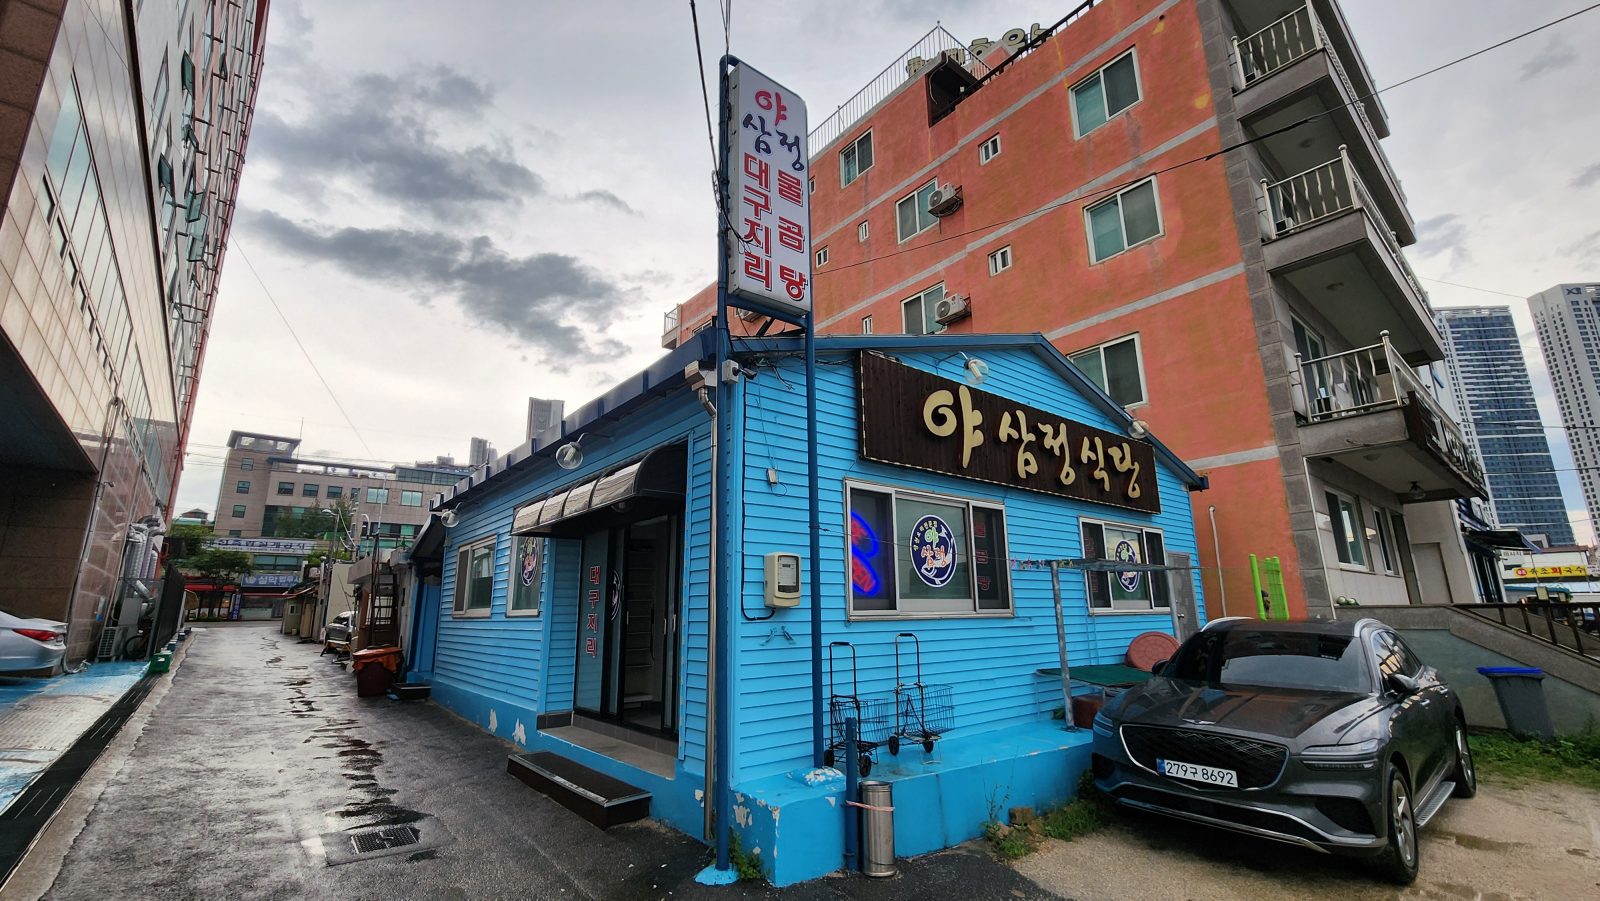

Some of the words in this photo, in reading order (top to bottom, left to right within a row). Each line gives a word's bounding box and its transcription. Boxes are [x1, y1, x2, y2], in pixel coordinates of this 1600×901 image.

[743, 151, 773, 293] 대구지리
[777, 168, 809, 302] 물곰탕
[586, 566, 601, 659] 대구지리
[1166, 762, 1198, 778] 279구
[1201, 768, 1234, 785] 8692
